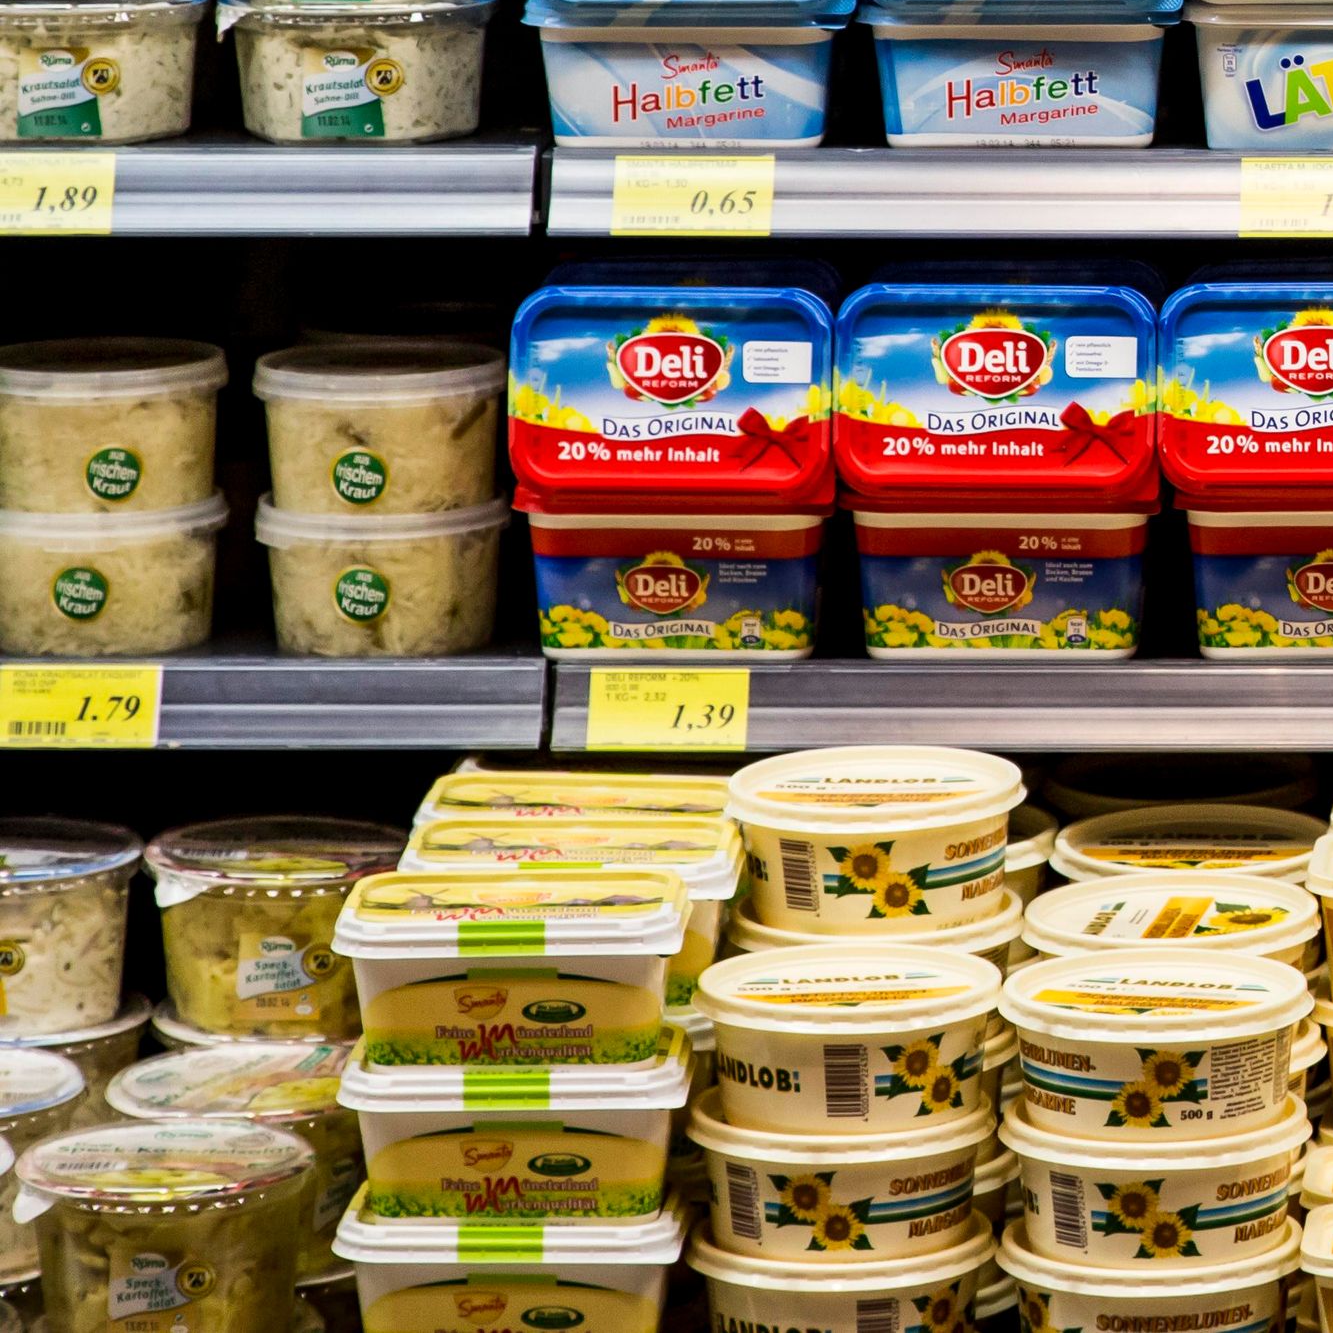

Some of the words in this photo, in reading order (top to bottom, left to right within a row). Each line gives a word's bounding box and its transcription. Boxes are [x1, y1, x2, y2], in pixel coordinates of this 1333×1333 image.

[612, 77, 764, 122] Halbfett
[666, 107, 765, 130] Margarine
[691, 191, 755, 216] 0,65
[635, 347, 707, 378] Deli
[603, 418, 641, 437] DAS
[648, 414, 735, 435] ORIGINAL
[557, 442, 609, 460] 20%
[616, 446, 662, 464] mehr
[667, 446, 720, 463] Inhalt
[340, 481, 377, 499] Kraut
[671, 704, 734, 729] 1,39
[1181, 1108, 1199, 1121] 500
